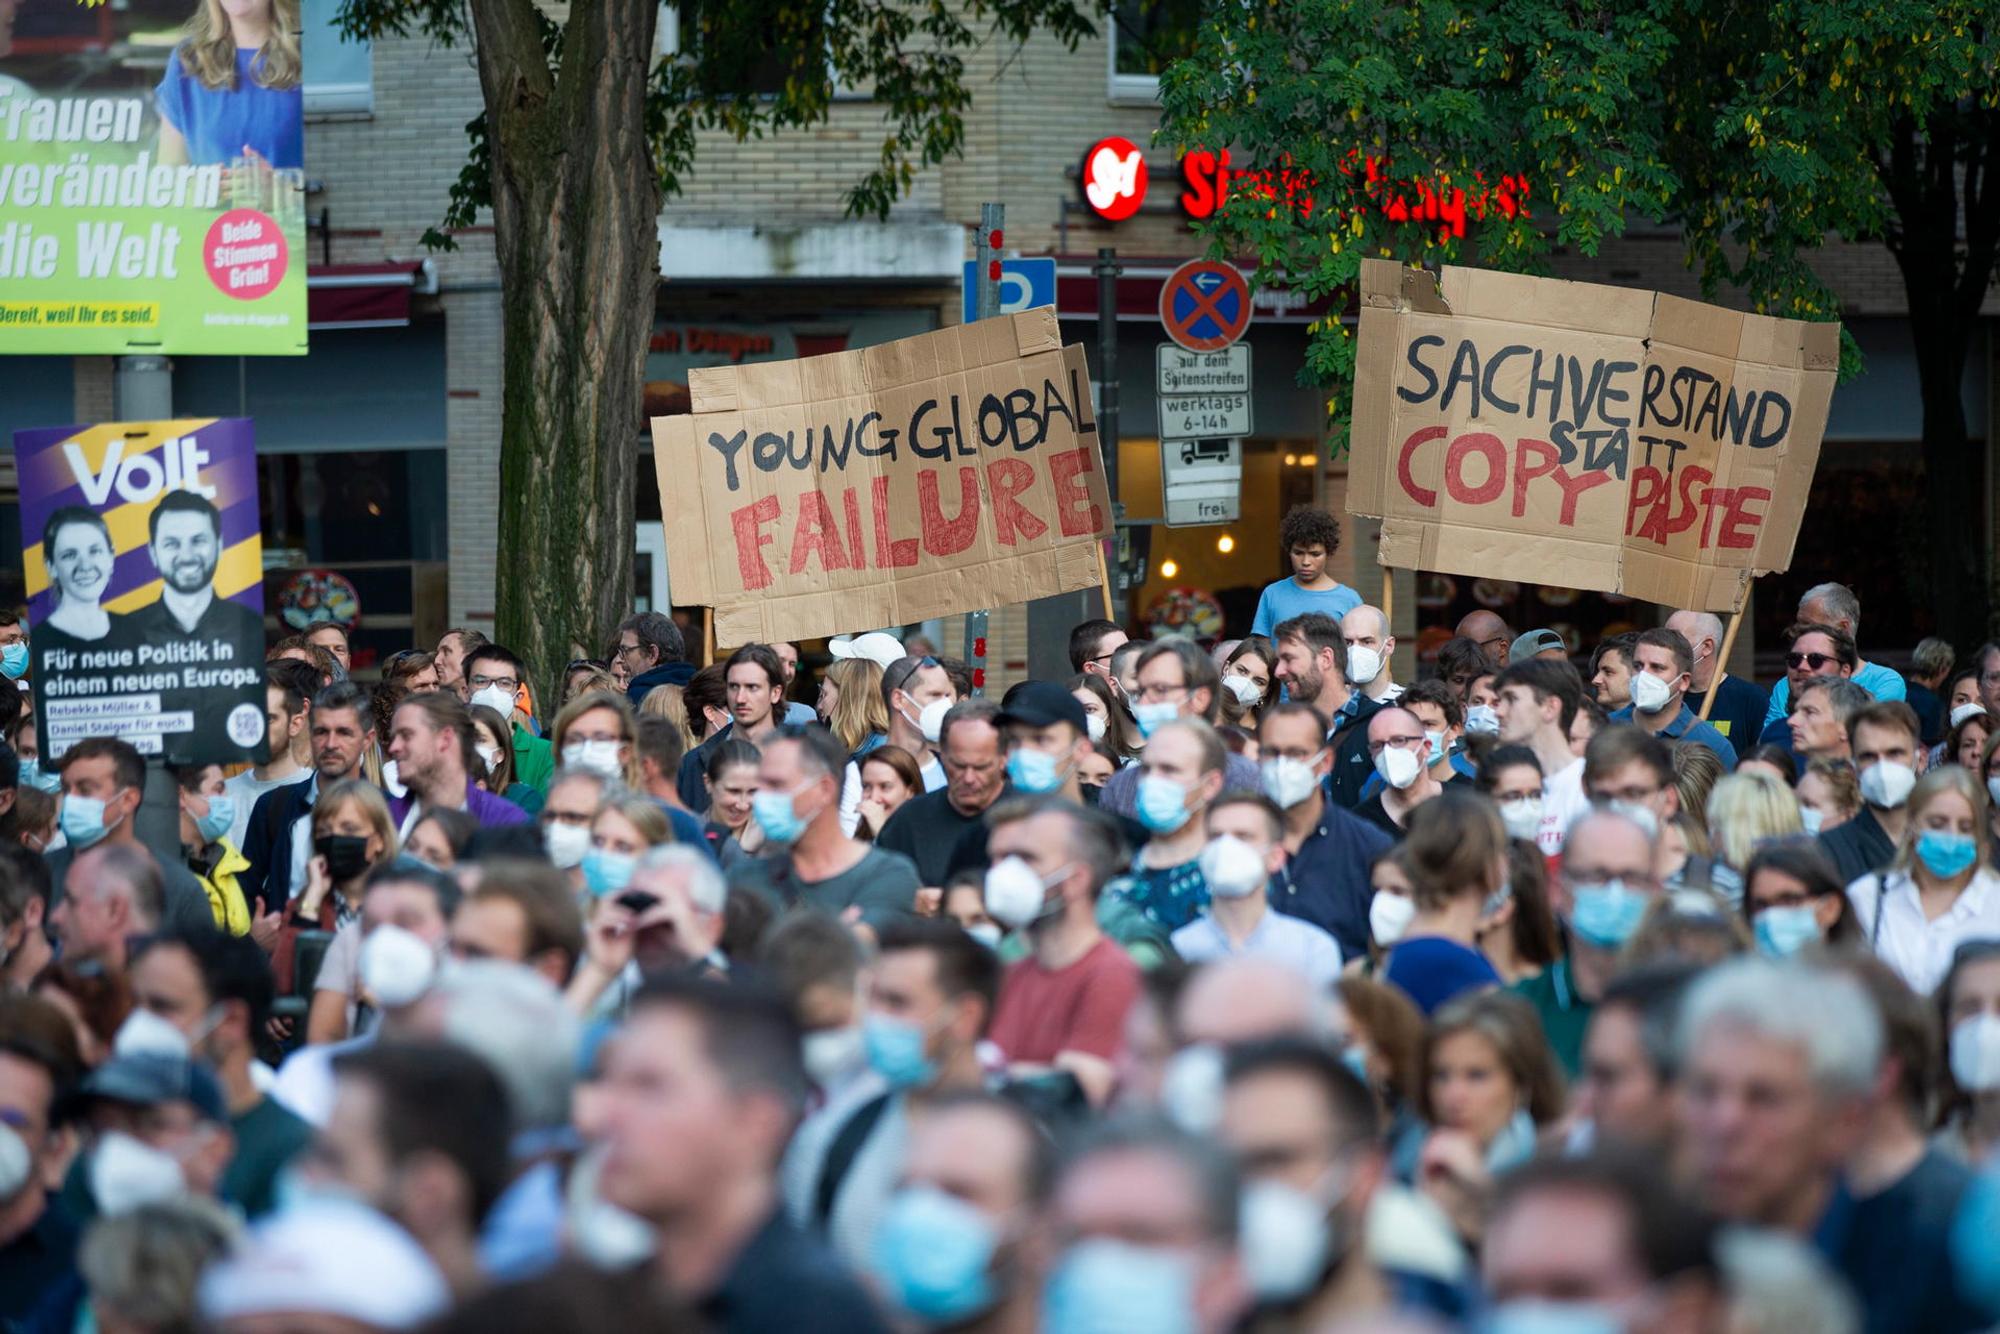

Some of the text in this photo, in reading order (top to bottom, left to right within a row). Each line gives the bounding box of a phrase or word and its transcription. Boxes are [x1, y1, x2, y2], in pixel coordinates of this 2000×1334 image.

[222, 219, 262, 244] Beide
[76, 221, 181, 280] Welt
[214, 242, 278, 268] Stimmen
[229, 262, 269, 288] Grün!
[46, 306, 75, 323] weil
[78, 306, 98, 322] Ihr
[101, 309, 118, 323] es
[122, 306, 154, 323] seid.
[1179, 354, 1229, 368] auf dem
[1164, 371, 1245, 386] Seitenstreifen
[1397, 335, 1792, 448] SACHVERSTAND
[1166, 397, 1243, 413] werktags
[708, 369, 1096, 491] YOUNG GLOBAL
[1549, 420, 1687, 481] STATT
[62, 436, 217, 506] Volt
[1397, 426, 1771, 549] COPY PASTE
[730, 447, 1104, 591] FAILURE
[1198, 501, 1227, 517] frei
[43, 638, 234, 671] Für neue Politik in
[44, 666, 261, 697] einem neuen Europa.
[49, 700, 153, 717] Rebekka Müller &
[51, 722, 88, 736] Daniel
[136, 720, 153, 731] für
[157, 717, 186, 729] euch
